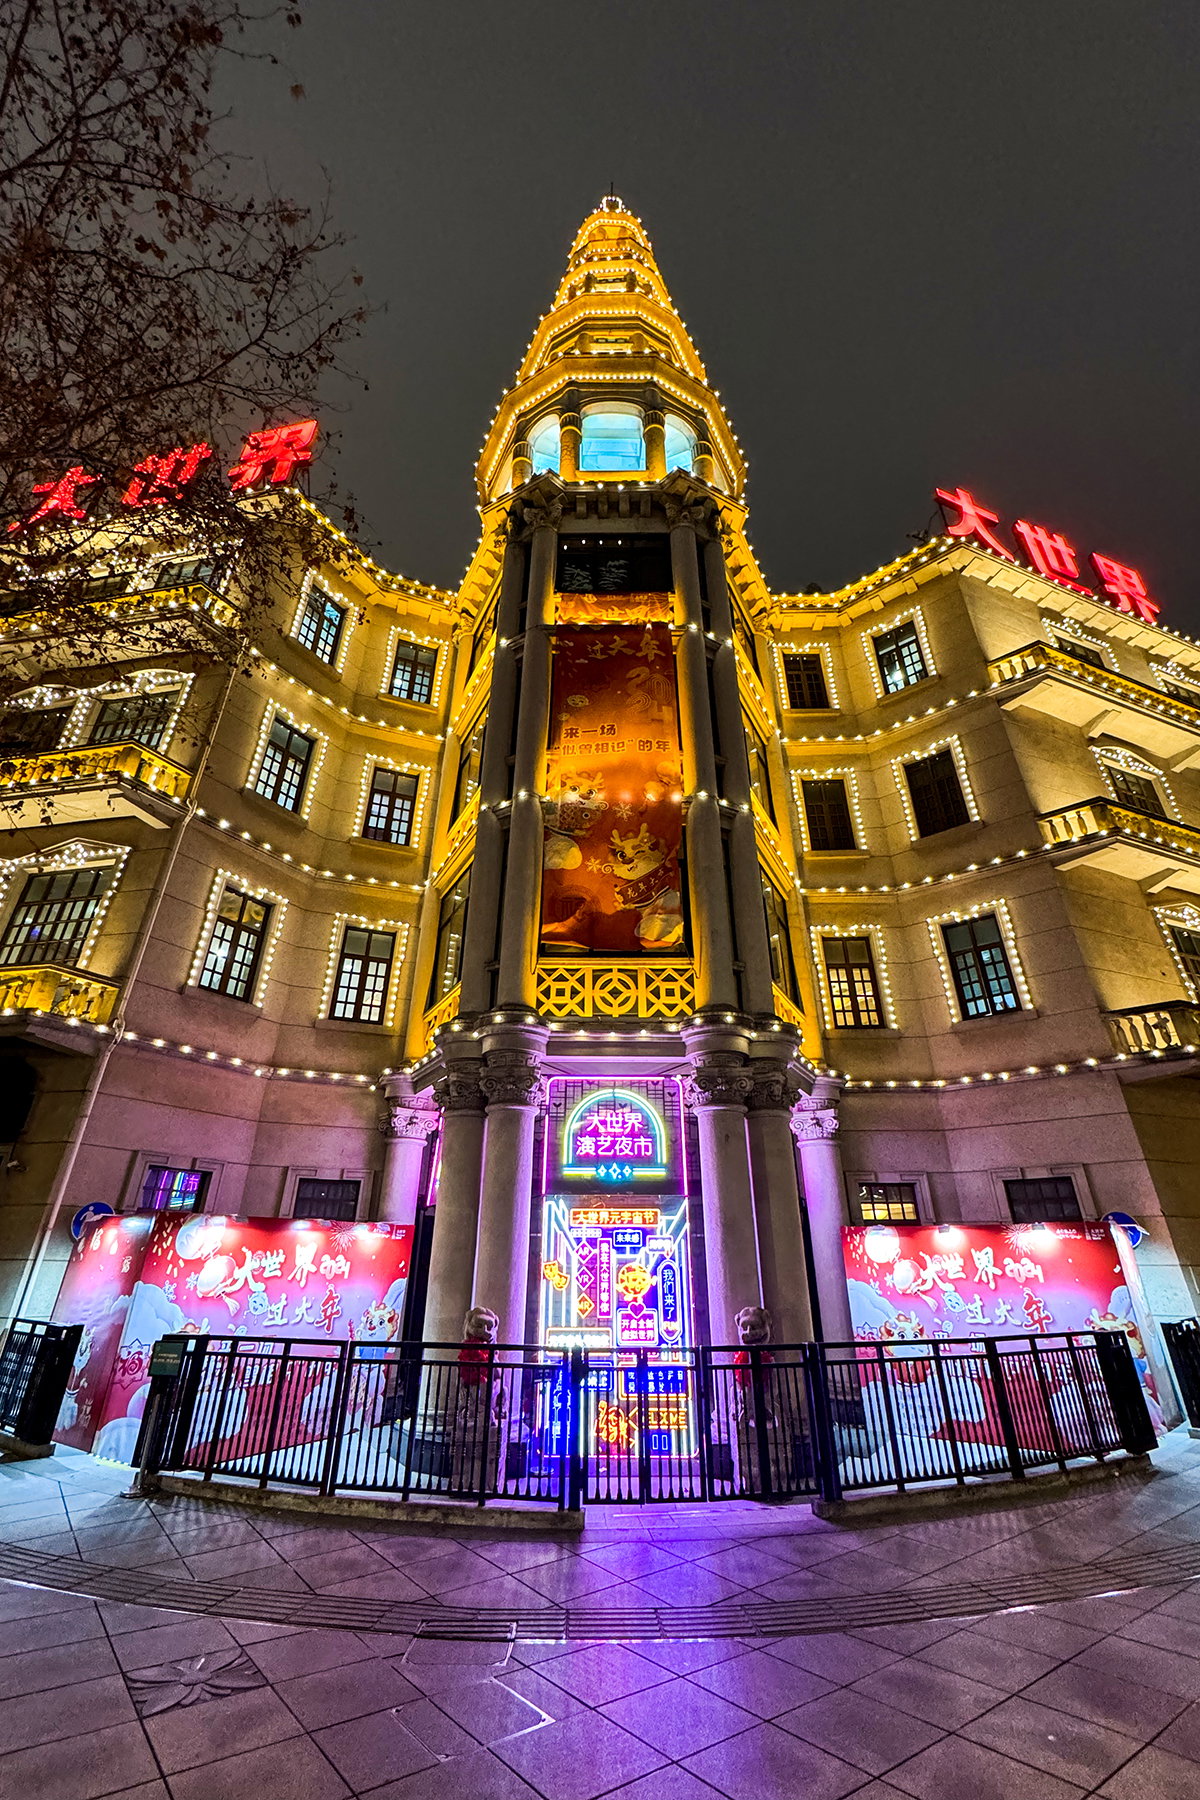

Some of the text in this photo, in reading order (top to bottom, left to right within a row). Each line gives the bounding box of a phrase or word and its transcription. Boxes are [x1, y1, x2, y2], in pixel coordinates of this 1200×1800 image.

[7, 419, 318, 532] 大世界
[934, 488, 1161, 624] 大世界
[563, 723, 617, 739] 来一场
[586, 1112, 644, 1133] 大世界
[576, 1136, 653, 1157] 演艺夜市
[576, 1211, 656, 1224] 大世界元宇宙节
[216, 1242, 317, 1292] 大世界
[910, 1246, 1003, 1292] 大世界
[262, 1286, 342, 1334] 过大年
[663, 1269, 676, 1320] 我们来了
[965, 1290, 1053, 1334] 过大年
